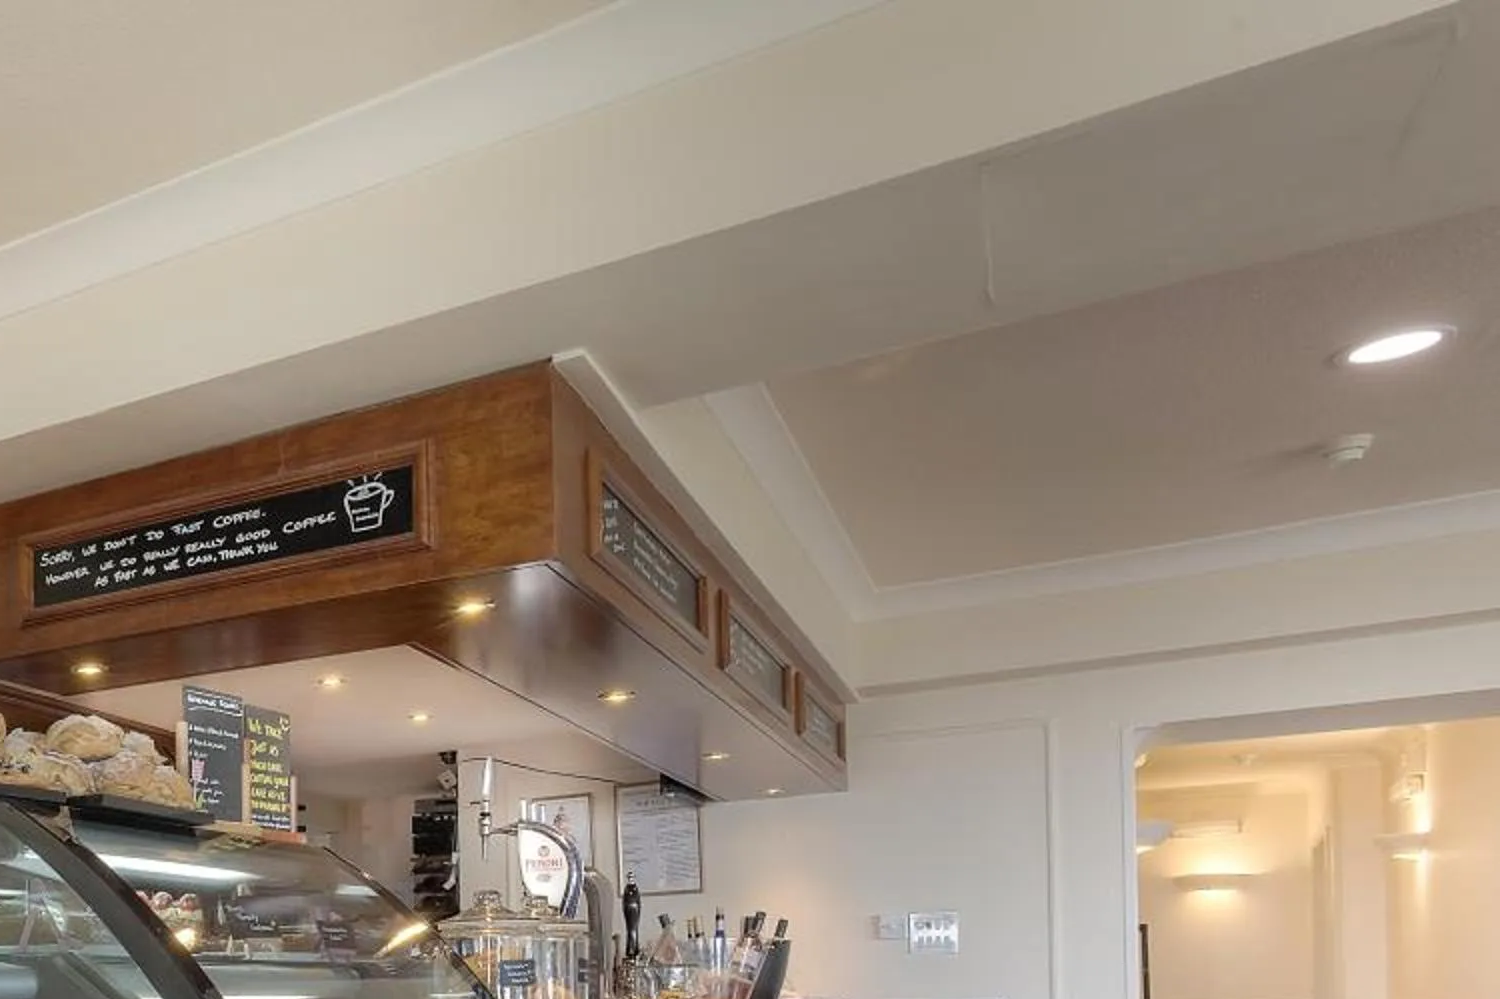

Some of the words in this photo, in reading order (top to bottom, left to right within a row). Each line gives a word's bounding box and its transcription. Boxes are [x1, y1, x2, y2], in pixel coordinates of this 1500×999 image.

[45, 567, 91, 586] HOWEVER
[100, 560, 116, 572] WE
[120, 557, 137, 567] DO
[143, 546, 180, 562] REALLY
[184, 536, 227, 554] REALLY
[235, 528, 271, 543] GOOD
[283, 511, 337, 533] COFFEE
[82, 544, 97, 557] WE
[145, 530, 165, 541] DO
[171, 519, 205, 536] FAST
[94, 575, 109, 587] AS
[114, 569, 138, 583] FAST
[142, 565, 156, 576] AS
[164, 559, 180, 571] WE
[218, 544, 255, 561] THANK
[256, 541, 279, 554] YOU
